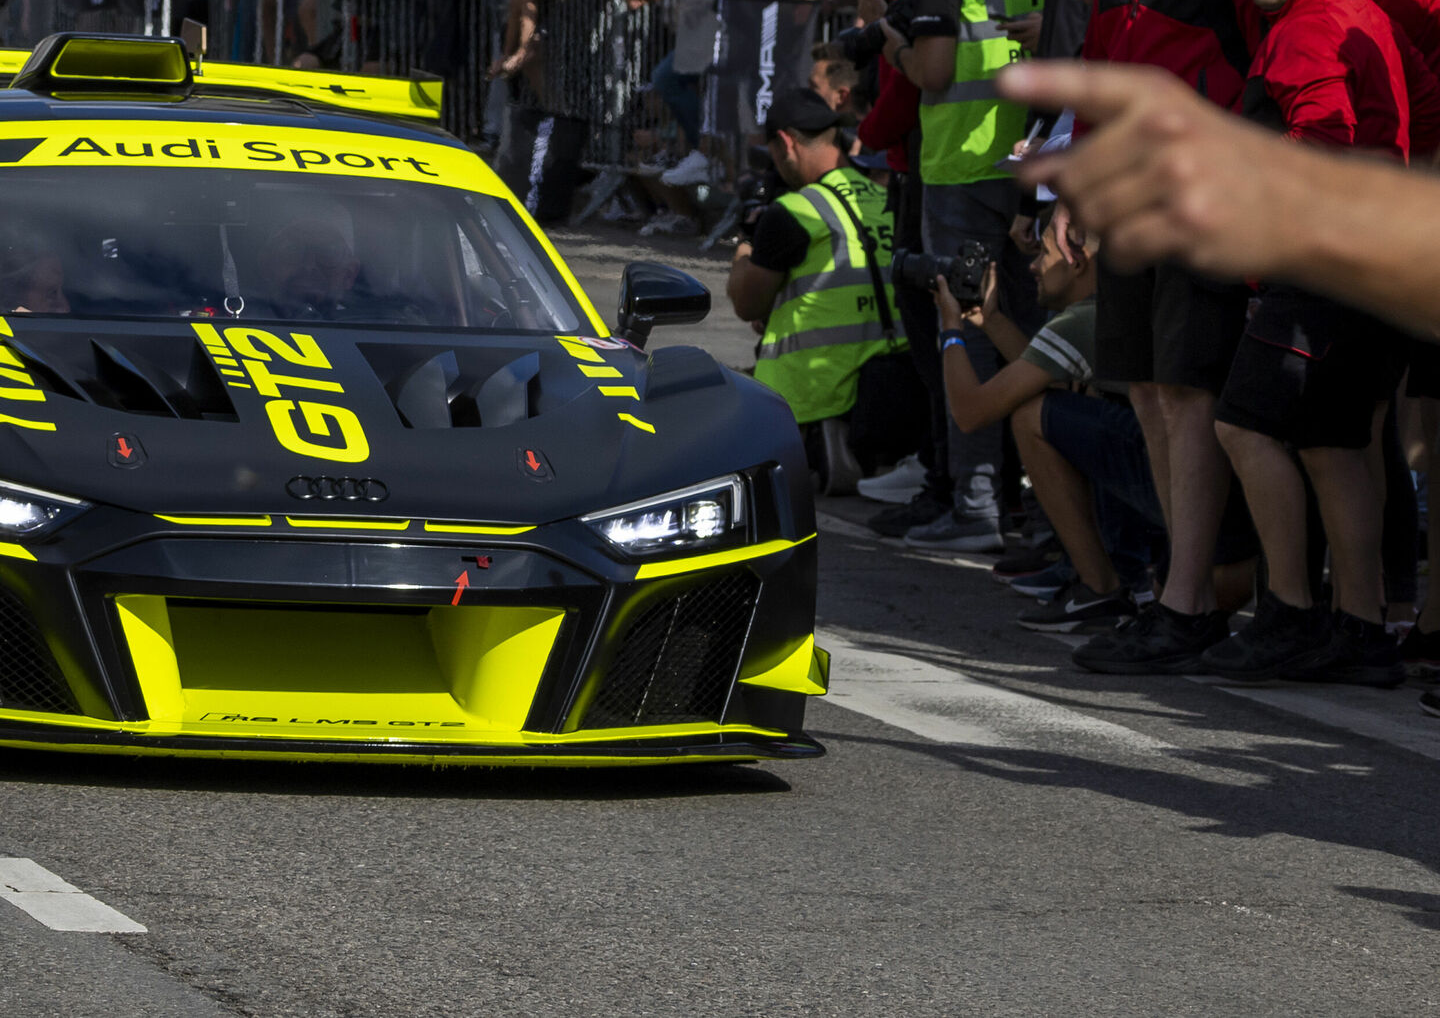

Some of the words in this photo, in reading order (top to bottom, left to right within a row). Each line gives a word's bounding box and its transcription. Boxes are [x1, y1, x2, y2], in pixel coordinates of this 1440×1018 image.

[57, 137, 222, 159] Audi
[243, 141, 440, 177] Sport
[223, 327, 370, 463] GT2
